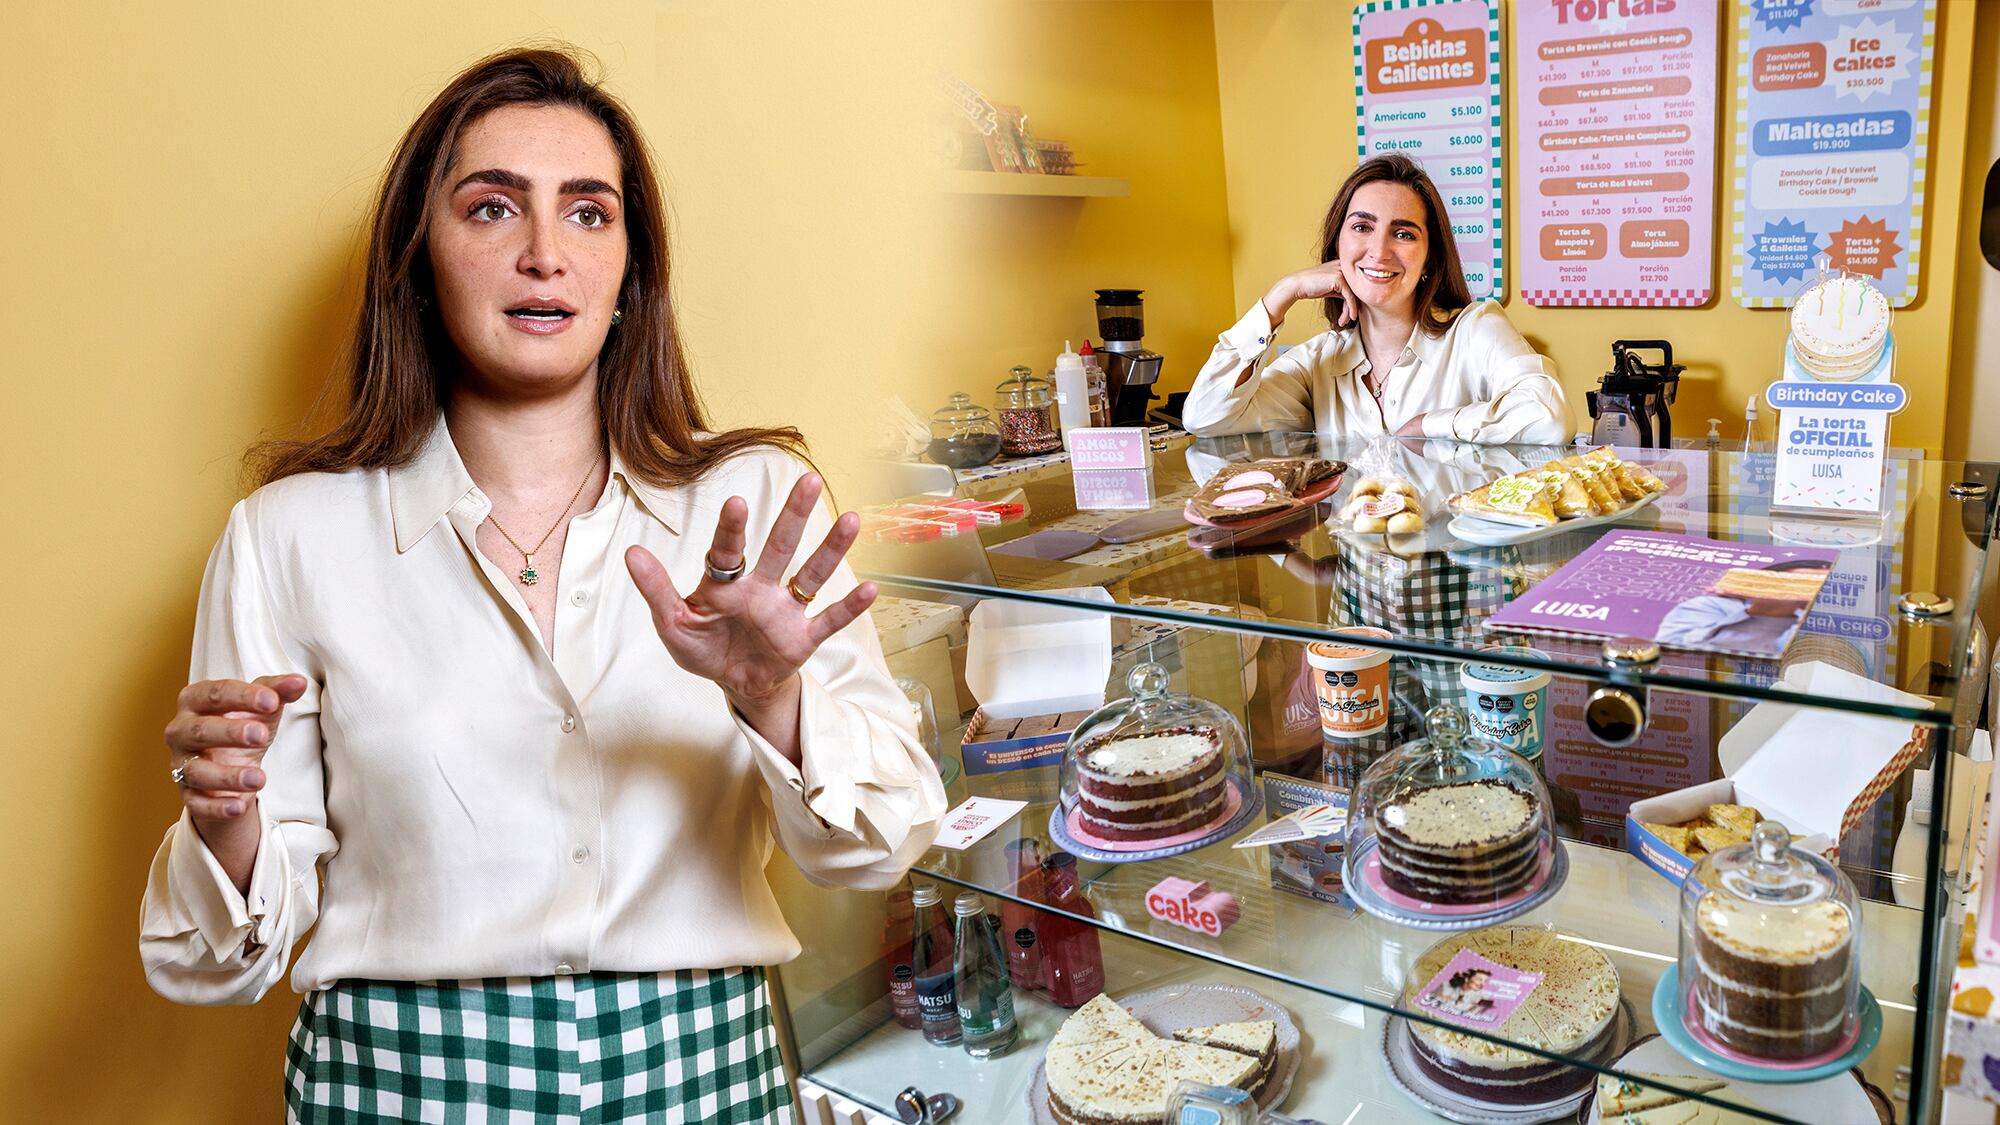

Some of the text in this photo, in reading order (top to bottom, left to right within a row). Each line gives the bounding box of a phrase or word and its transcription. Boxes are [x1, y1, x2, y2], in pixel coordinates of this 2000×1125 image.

[1552, 0, 1676, 24] Tortas
[1768, 9, 1799, 20] $11.100
[1543, 47, 1565, 55] Torta
[1566, 45, 1576, 53] de
[1576, 40, 1611, 52] Brownie
[1629, 36, 1657, 47] Cookie
[1659, 33, 1686, 45] Dough
[1850, 38, 1880, 53] Ice
[1383, 39, 1467, 63] Bebidas
[1662, 52, 1693, 61] Porción
[1766, 51, 1810, 61] Zanahoria
[1663, 62, 1690, 71] $11.200
[1766, 60, 1811, 71] Red Velvet
[1833, 55, 1896, 72] Cakes
[1378, 62, 1474, 85] Calientes
[1759, 71, 1819, 83] Birthday Cake
[1847, 78, 1884, 88] $30.500
[1577, 85, 1653, 98] Torta de Zanahoria
[1664, 100, 1694, 109] Porción
[1374, 105, 1482, 122] Americano $5.100
[1665, 110, 1693, 119] $11.200
[1768, 118, 1895, 141] Malteadas
[1375, 135, 1482, 151] Café Latte $6.000
[1543, 129, 1686, 147] Birthday Cake/Torta de Cumpleaños
[1813, 140, 1850, 150] $19.900
[1664, 149, 1695, 157] Porción
[1666, 158, 1694, 167] $11.200
[1451, 166, 1483, 176] $5.800
[1780, 169, 1823, 177] Zanahoria
[1610, 180, 1625, 188] Red
[1627, 179, 1653, 187] Velvet
[1779, 179, 1814, 187] Birthday
[1844, 176, 1878, 184] Brownie
[1799, 187, 1856, 196] Cookie Dough
[1452, 196, 1484, 206] $6.300
[1662, 195, 1693, 203] Porción
[1664, 205, 1691, 213] $11.200
[1452, 225, 1484, 235] $6.300
[1554, 239, 1595, 247] Amapola y
[1631, 239, 1679, 250] Almojábana
[1761, 235, 1806, 244] Brownies
[1845, 238, 1872, 246] Torta
[1562, 248, 1586, 256] Limón
[1770, 244, 1808, 252] Galletas
[1559, 265, 1587, 273] Porción
[1762, 262, 1778, 270] Caja
[1640, 274, 1668, 282] $12.700
[1777, 388, 1896, 406] Birthday Cake
[1798, 416, 1866, 430] La torta
[1789, 430, 1872, 447] OFICIAL
[1077, 439, 1118, 450] AMOR
[1077, 451, 1125, 462] DISCOS
[1786, 447, 1874, 459] de cumpleaños
[1812, 464, 1842, 478] LUISA
[1490, 489, 1527, 503] Pie
[1604, 544, 1749, 566] productos
[1614, 540, 1734, 559] Catálogo
[1740, 553, 1776, 563] de
[1530, 600, 1610, 620] LUISA
[1316, 684, 1384, 723] LUISA
[1282, 700, 1314, 729] LUIS
[1506, 718, 1531, 736] Cake
[1044, 742, 1066, 750] conce
[1280, 801, 1302, 810] como
[1149, 894, 1217, 933] cake
[1072, 966, 1094, 980] HATSU
[918, 993, 951, 1006] HATSU
